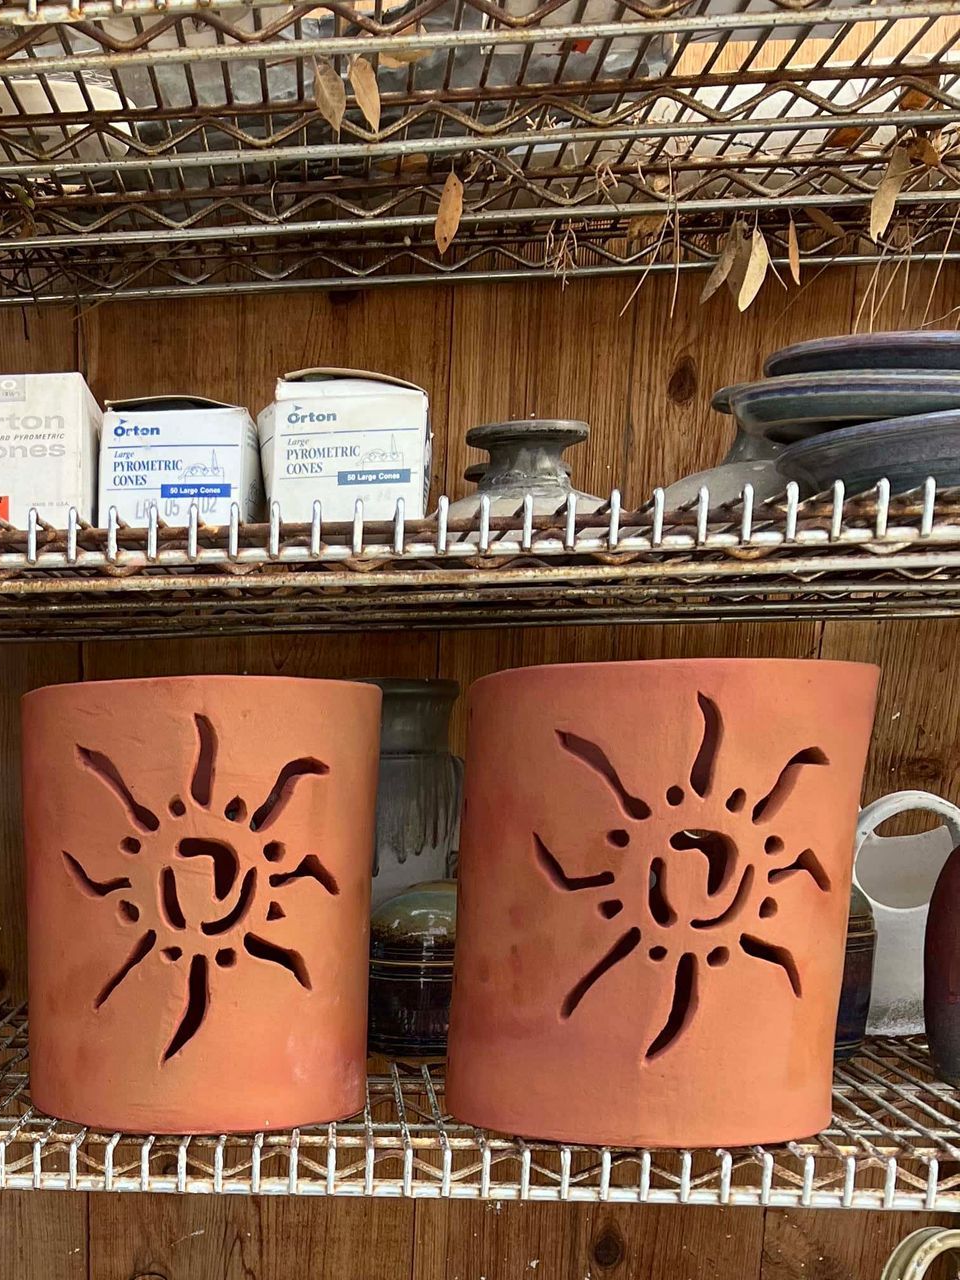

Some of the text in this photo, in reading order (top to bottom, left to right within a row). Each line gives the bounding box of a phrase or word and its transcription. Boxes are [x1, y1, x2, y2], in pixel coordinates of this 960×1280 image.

[287, 411, 337, 424] Orton
[13, 433, 65, 441] PYROMETRIC
[113, 424, 160, 437] Orton
[287, 438, 310, 447] Large
[114, 450, 135, 459] Large
[286, 445, 361, 461] PYROMETRIC
[113, 459, 183, 473] PYROMETRIC
[286, 462, 323, 475] CONES
[113, 474, 147, 487] CONES
[347, 472, 400, 482] 50 Large Cones
[180, 487, 199, 496] Large
[200, 486, 221, 494] Cones
